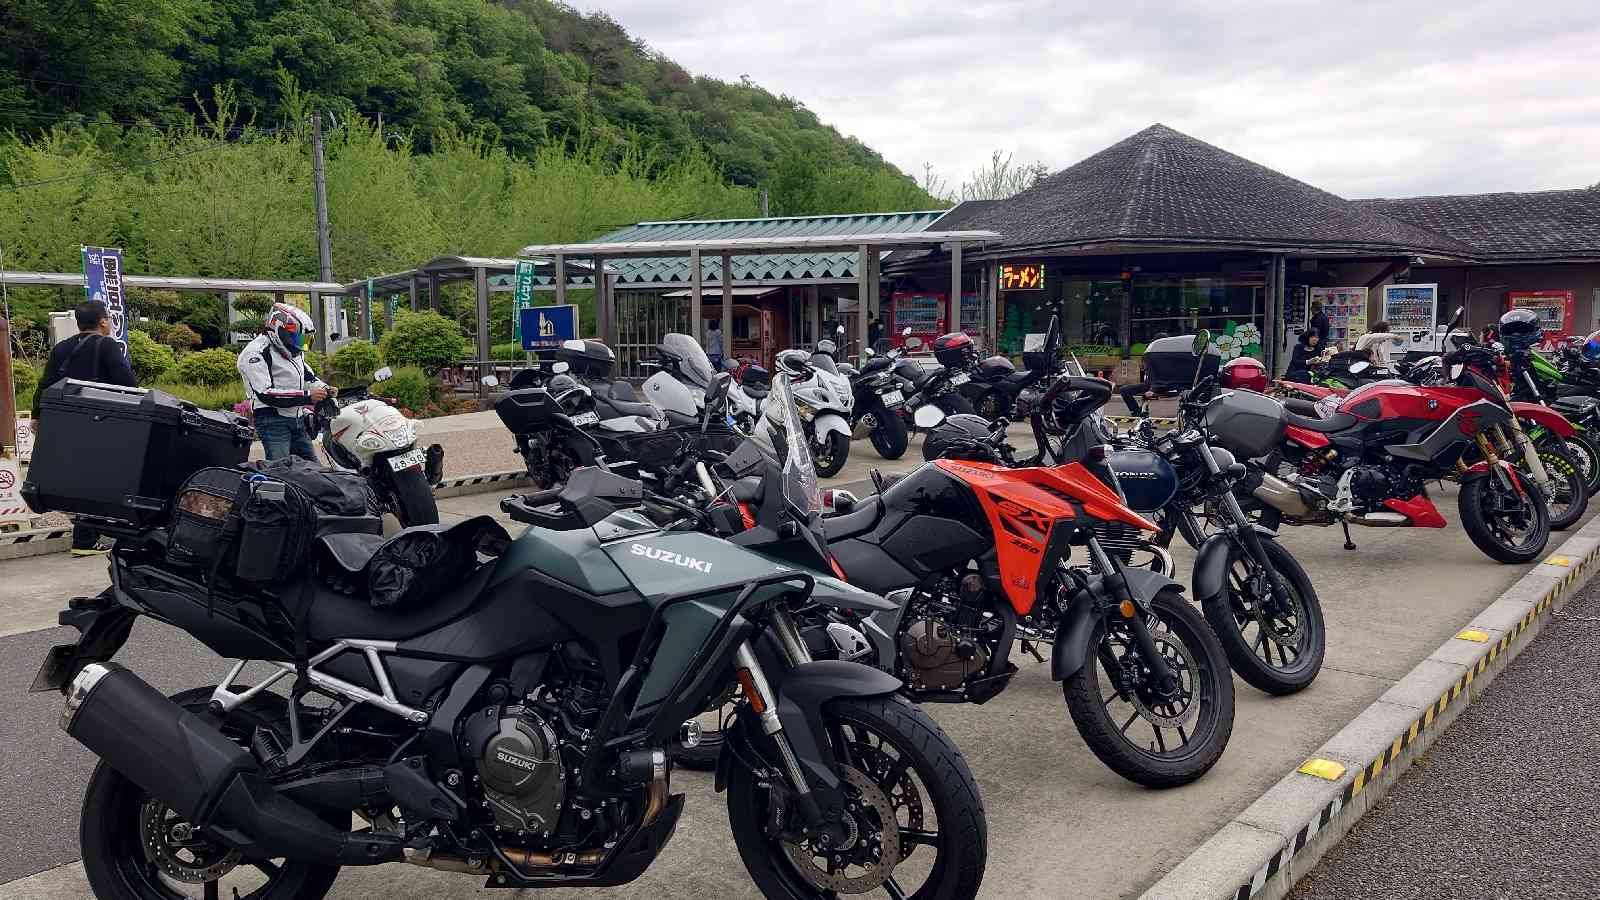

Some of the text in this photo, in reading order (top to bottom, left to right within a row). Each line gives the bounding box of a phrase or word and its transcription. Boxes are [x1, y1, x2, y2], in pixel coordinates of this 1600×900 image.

[1004, 266, 1040, 288] ラーメン
[631, 543, 713, 574] SUZUKI
[497, 752, 535, 771] SUZUKI
